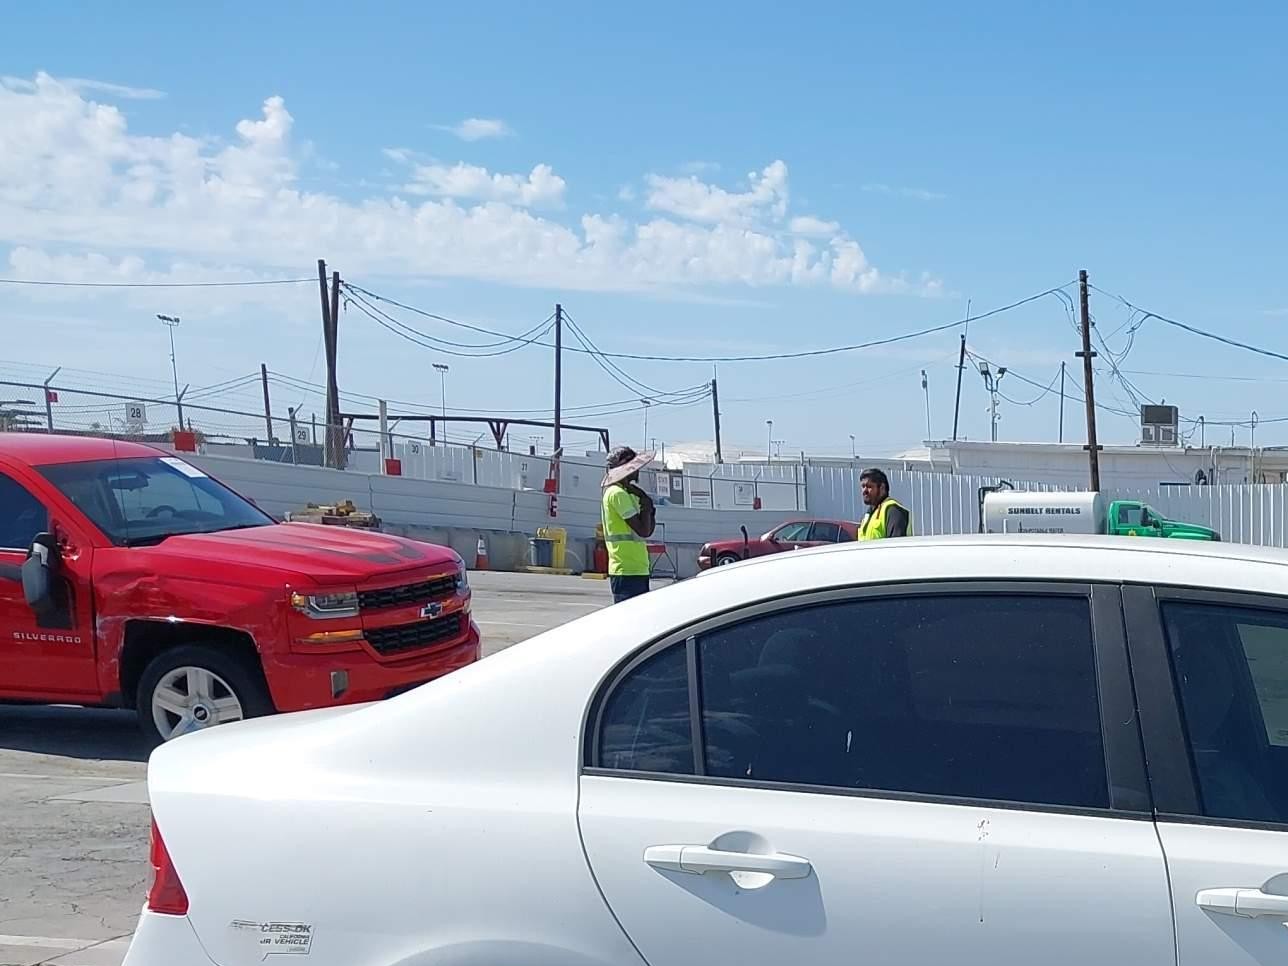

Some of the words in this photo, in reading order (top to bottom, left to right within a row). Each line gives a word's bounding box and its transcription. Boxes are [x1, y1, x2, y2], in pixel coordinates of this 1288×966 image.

[130, 407, 141, 418] 28
[297, 430, 307, 440] 29
[1008, 507, 1043, 515] SUNBELT
[1045, 507, 1080, 515] RENTALS
[13, 632, 81, 643] SILVERADO
